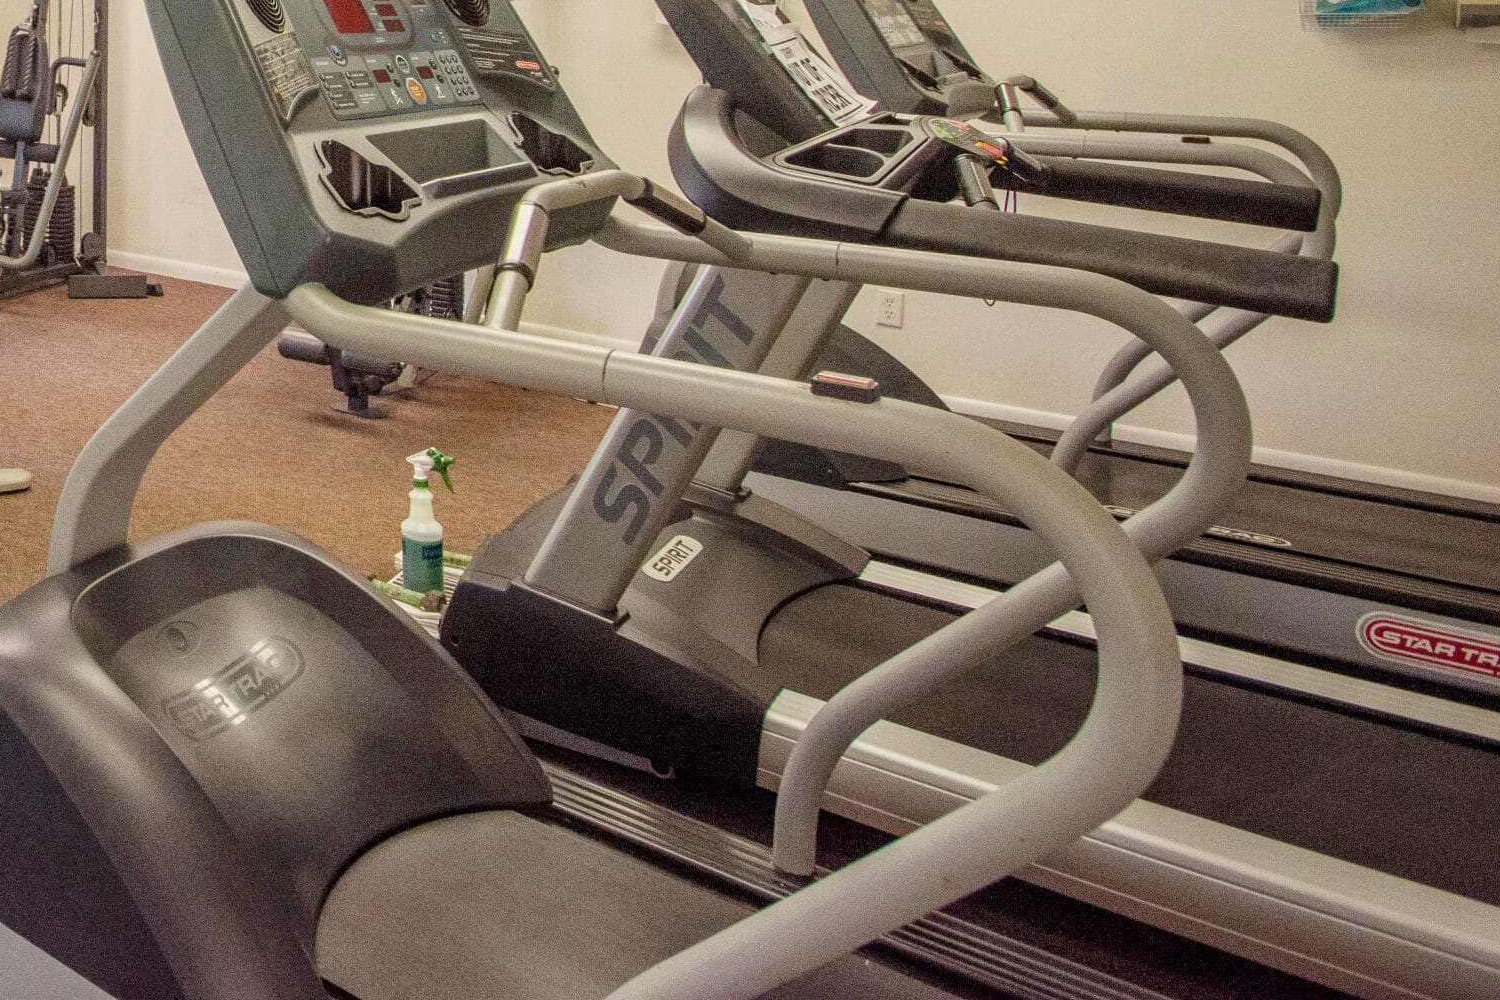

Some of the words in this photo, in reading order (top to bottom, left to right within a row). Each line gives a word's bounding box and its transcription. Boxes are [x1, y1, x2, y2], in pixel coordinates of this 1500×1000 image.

[593, 273, 755, 546] SPIIT
[651, 539, 694, 577] SPIRIT
[1378, 629, 1457, 658] STAR
[1460, 646, 1500, 668] TR
